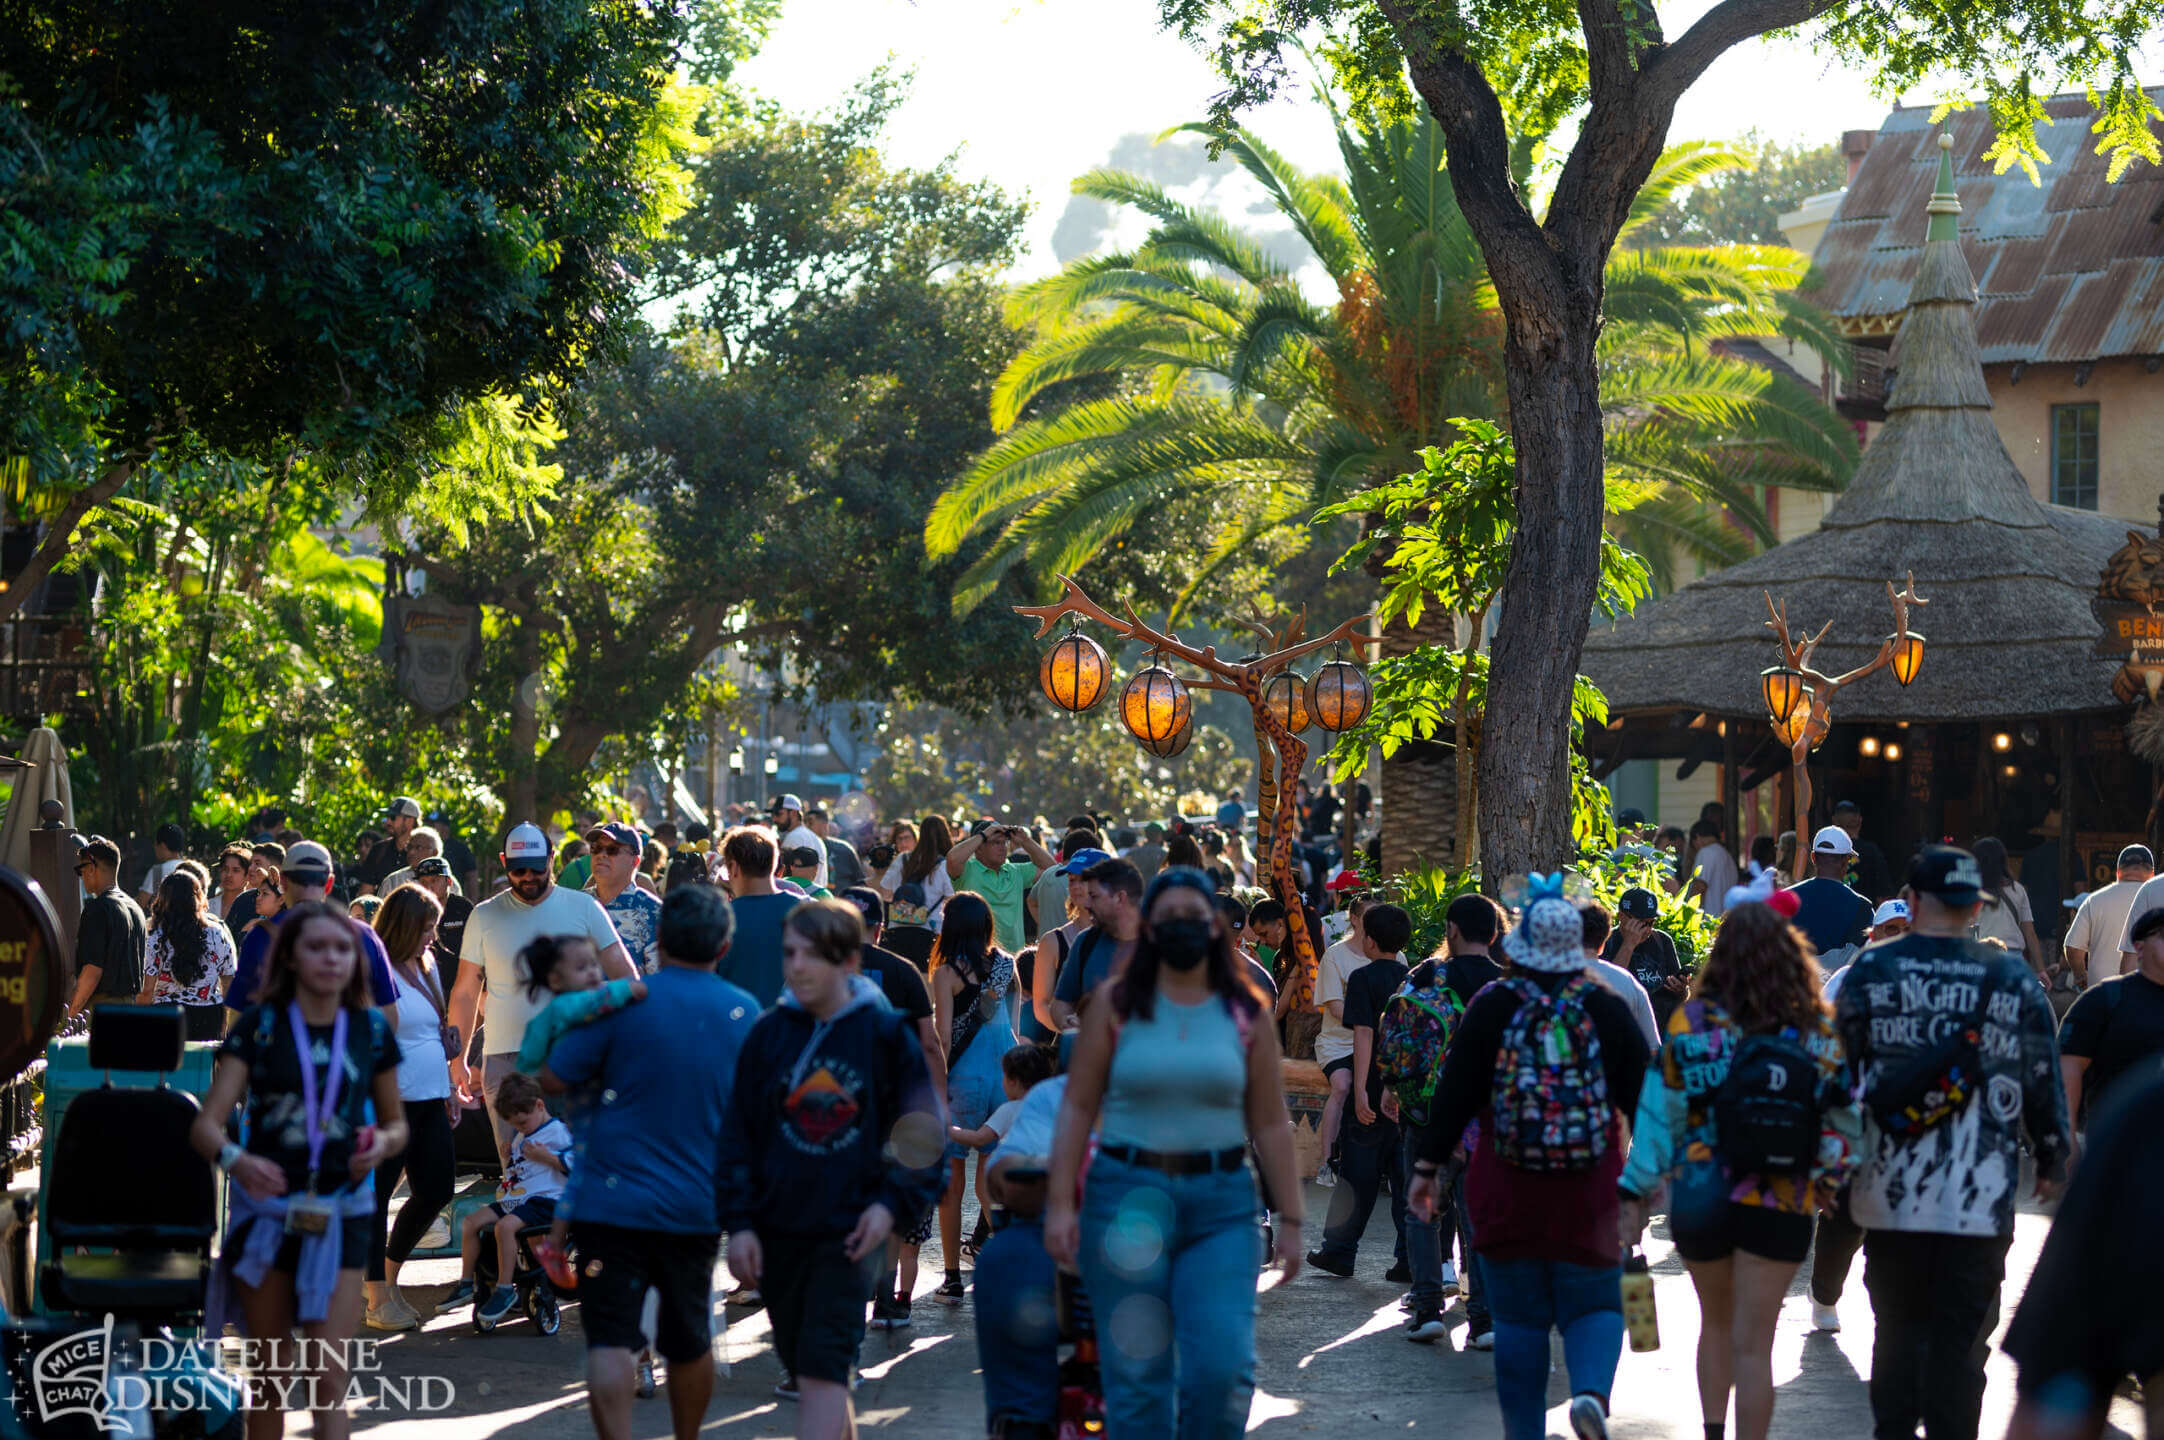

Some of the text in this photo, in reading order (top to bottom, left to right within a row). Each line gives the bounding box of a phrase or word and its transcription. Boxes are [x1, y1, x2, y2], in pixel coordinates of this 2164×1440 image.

[2118, 617, 2164, 638] BEN
[2133, 639, 2164, 649] BARB
[1766, 1063, 1787, 1092] D
